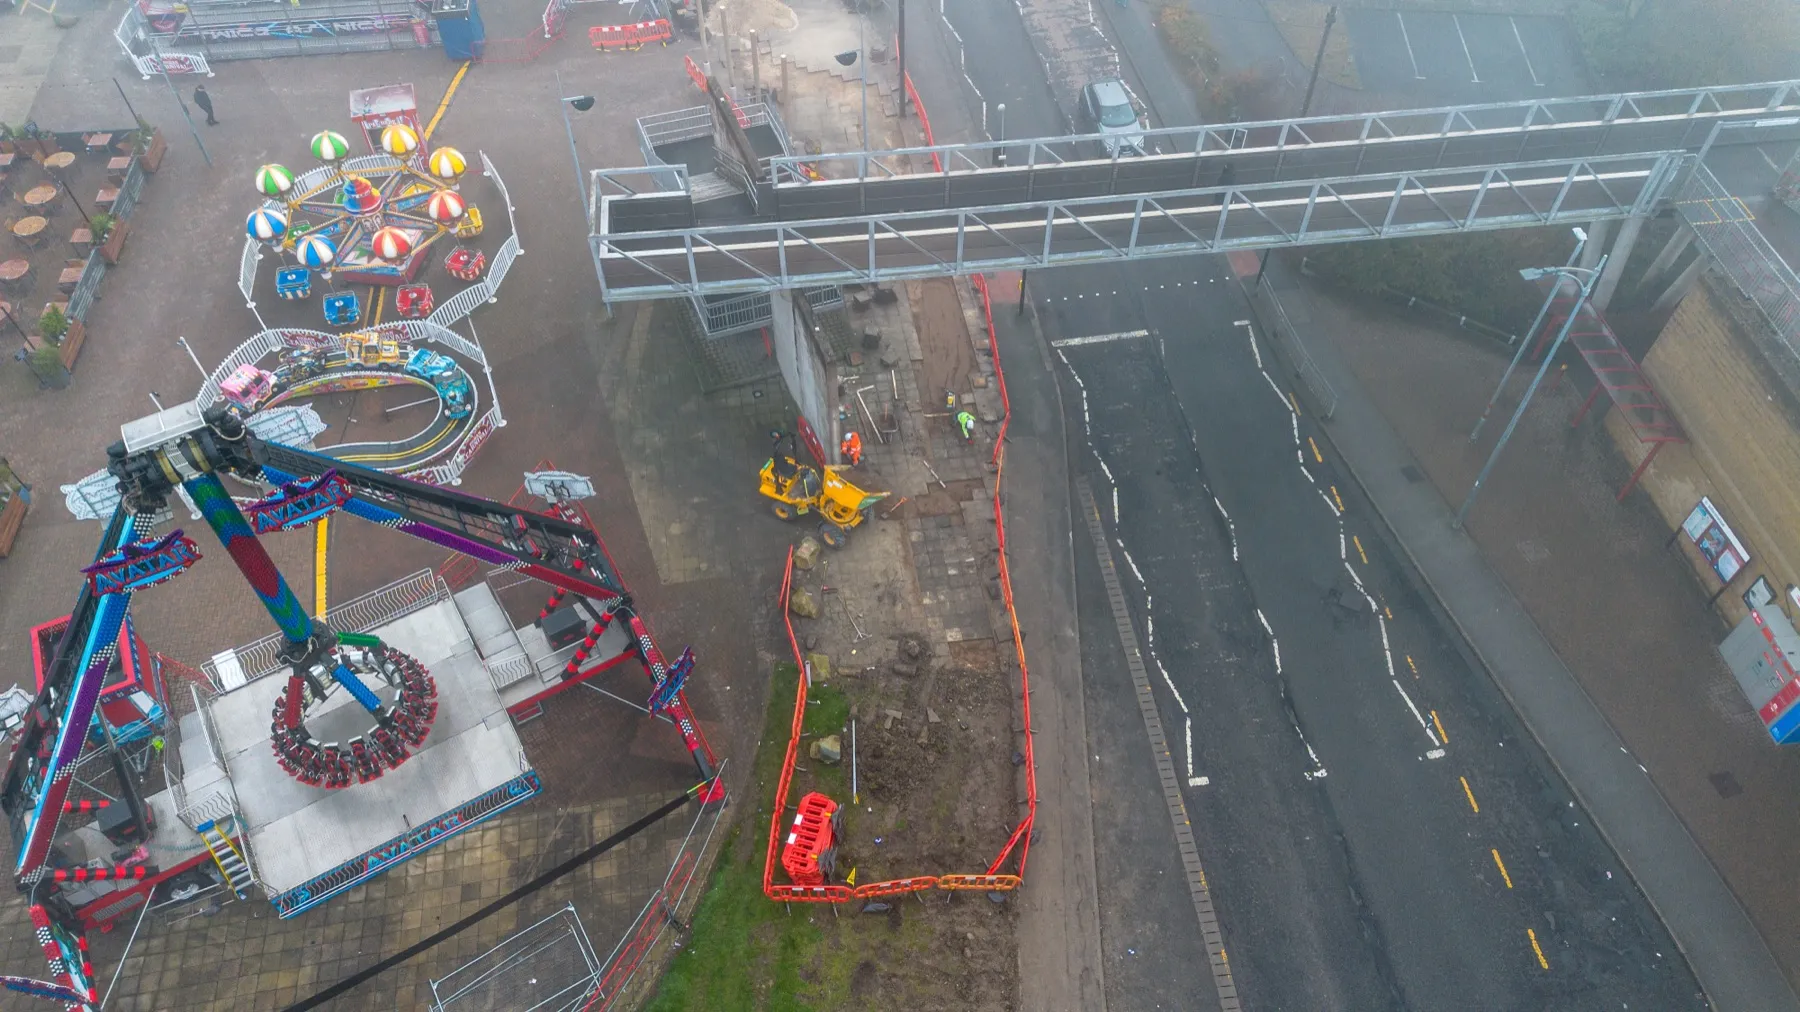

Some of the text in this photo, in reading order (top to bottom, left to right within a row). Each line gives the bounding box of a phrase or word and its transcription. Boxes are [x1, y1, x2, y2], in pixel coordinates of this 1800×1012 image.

[257, 484, 347, 533] AVATAR
[95, 544, 196, 593] AVATAR
[367, 815, 463, 871] AVATAR
